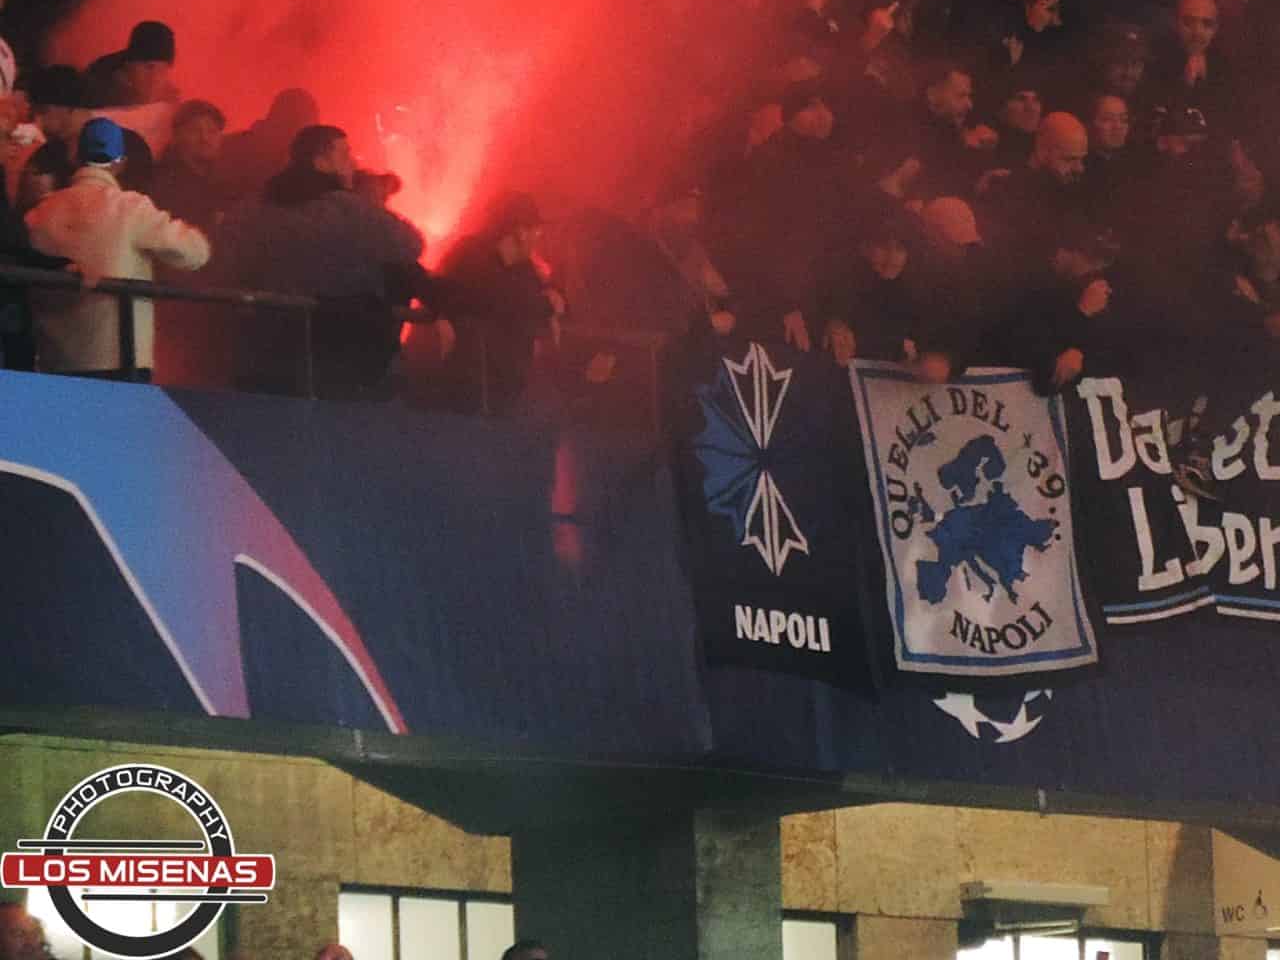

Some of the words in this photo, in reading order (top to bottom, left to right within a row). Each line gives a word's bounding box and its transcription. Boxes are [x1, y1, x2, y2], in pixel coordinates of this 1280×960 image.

[886, 394, 942, 540] QUELLI
[948, 386, 1010, 433] DEL
[734, 603, 832, 653] NAPOLI
[949, 600, 1053, 654] NAPOLI
[1221, 905, 1245, 923] WC
